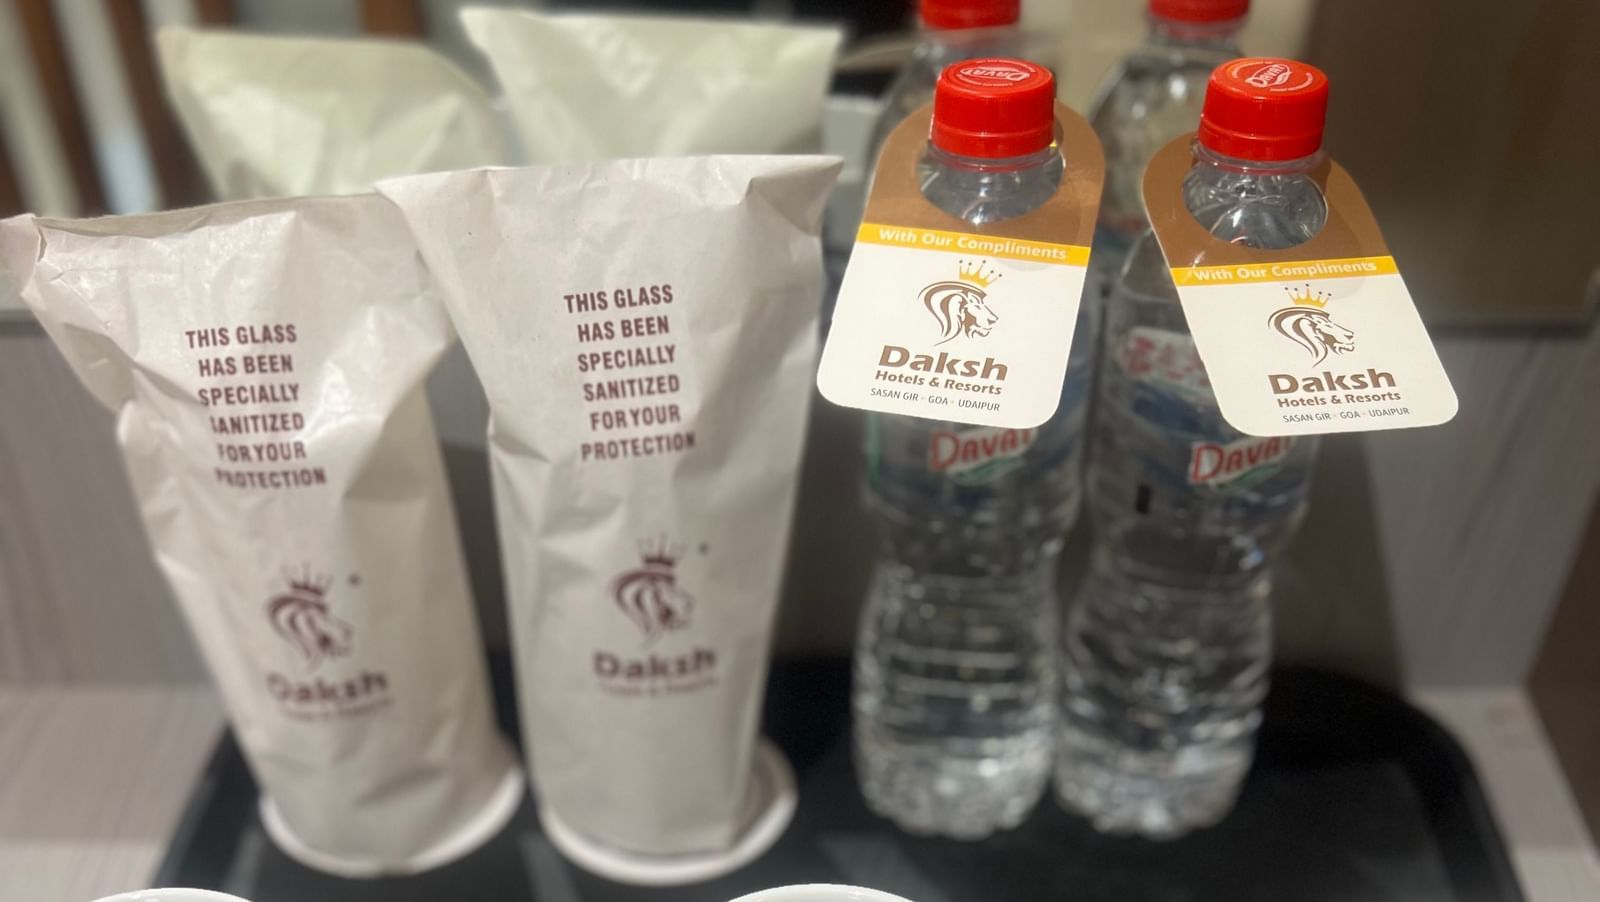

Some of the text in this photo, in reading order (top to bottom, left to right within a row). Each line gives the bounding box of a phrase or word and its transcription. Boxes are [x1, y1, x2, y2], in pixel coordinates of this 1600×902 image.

[879, 228, 1067, 259] With Our Compliments
[1194, 261, 1377, 281] With Our Compliments
[564, 284, 673, 314] THIS GLASS
[185, 324, 297, 349] THIS GLASS
[577, 315, 670, 343] HAS BEEN
[198, 354, 293, 377] HAS BEEN
[578, 344, 675, 373] SPECIALLY
[878, 345, 1008, 381] Daksh
[583, 374, 680, 402] SANITIZED
[875, 370, 1003, 395] Hotels & Resorts
[1268, 368, 1396, 394] Daksh
[198, 383, 299, 407] SPECIALLY
[870, 387, 1000, 411] SASAN GIR GOA UDAIPUR
[1277, 392, 1401, 408] Hotels & Resorts
[590, 404, 681, 431] FOR YOUR
[1282, 407, 1410, 423] SASAN GIR GOA UDAIPUR
[254, 441, 306, 462] YOUR
[581, 432, 696, 461] PROTECTION
